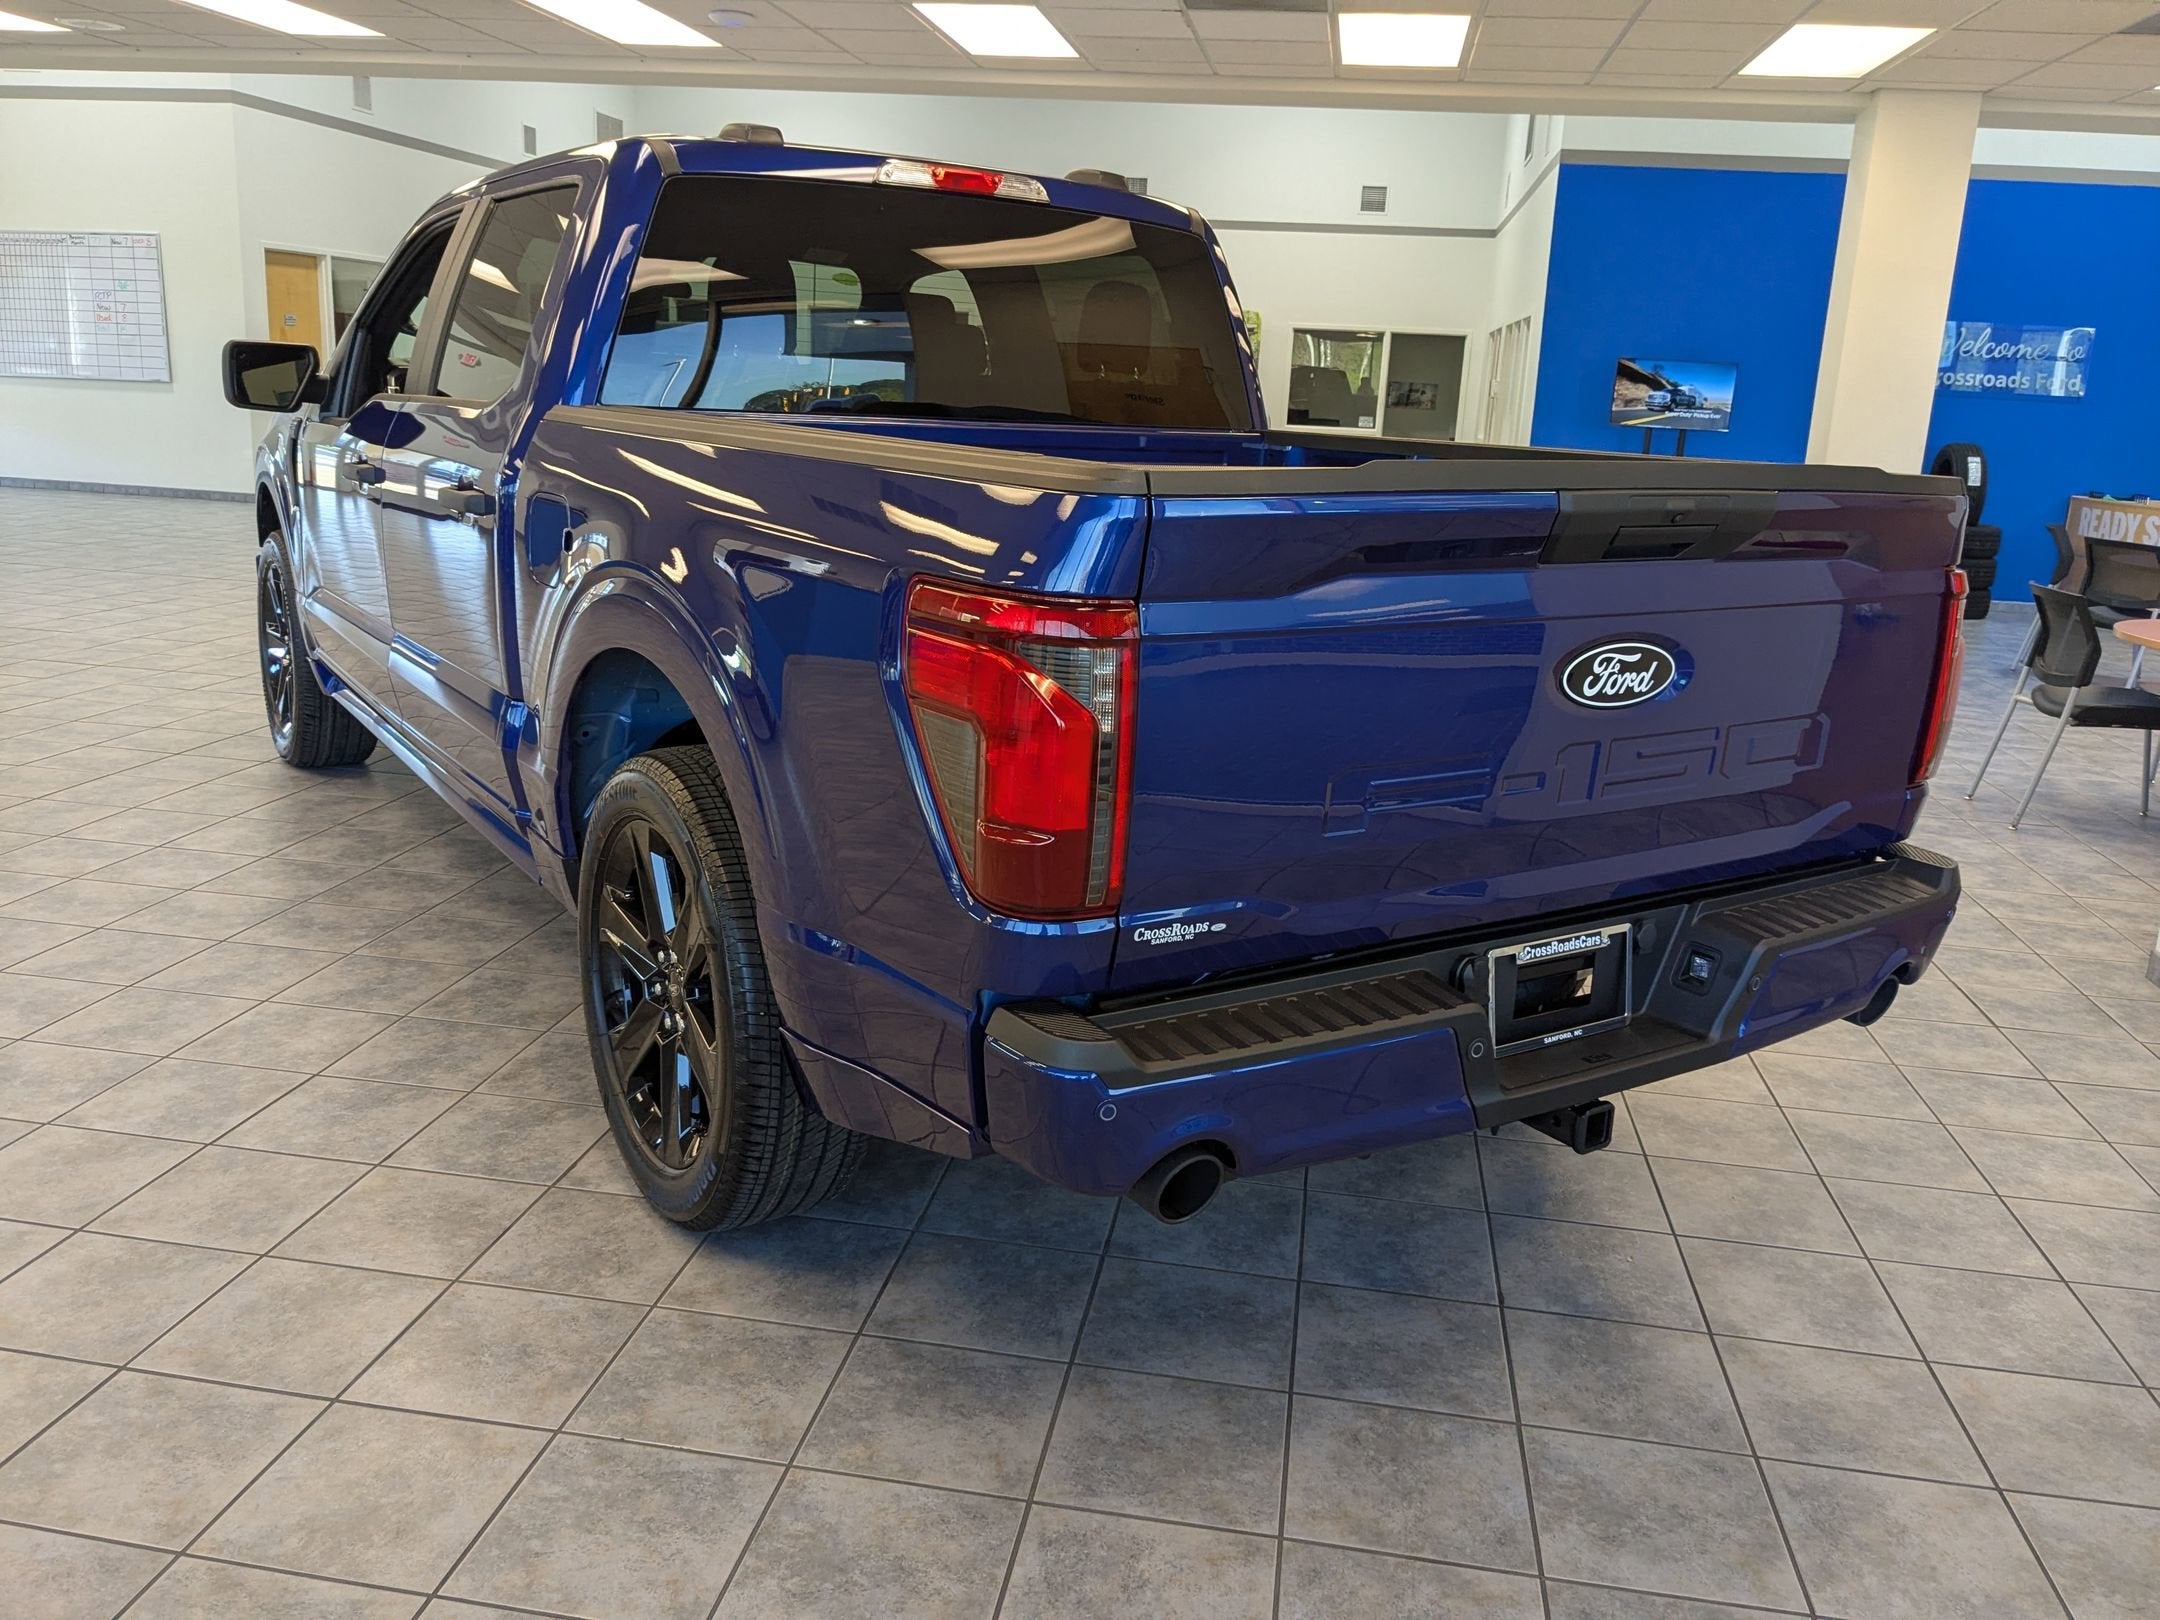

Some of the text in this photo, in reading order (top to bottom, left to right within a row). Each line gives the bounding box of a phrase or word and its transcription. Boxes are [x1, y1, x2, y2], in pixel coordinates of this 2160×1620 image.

[1936, 370, 2029, 389] rossroads
[2078, 507, 2160, 547] READY S
[1583, 653, 1658, 697] Ford
[1321, 712, 1831, 837] F-150
[1151, 935, 1183, 945] SANFORD,
[1524, 935, 1601, 961] CrossRoadsCars
[1544, 1029, 1583, 1044] SANFORD, NC
